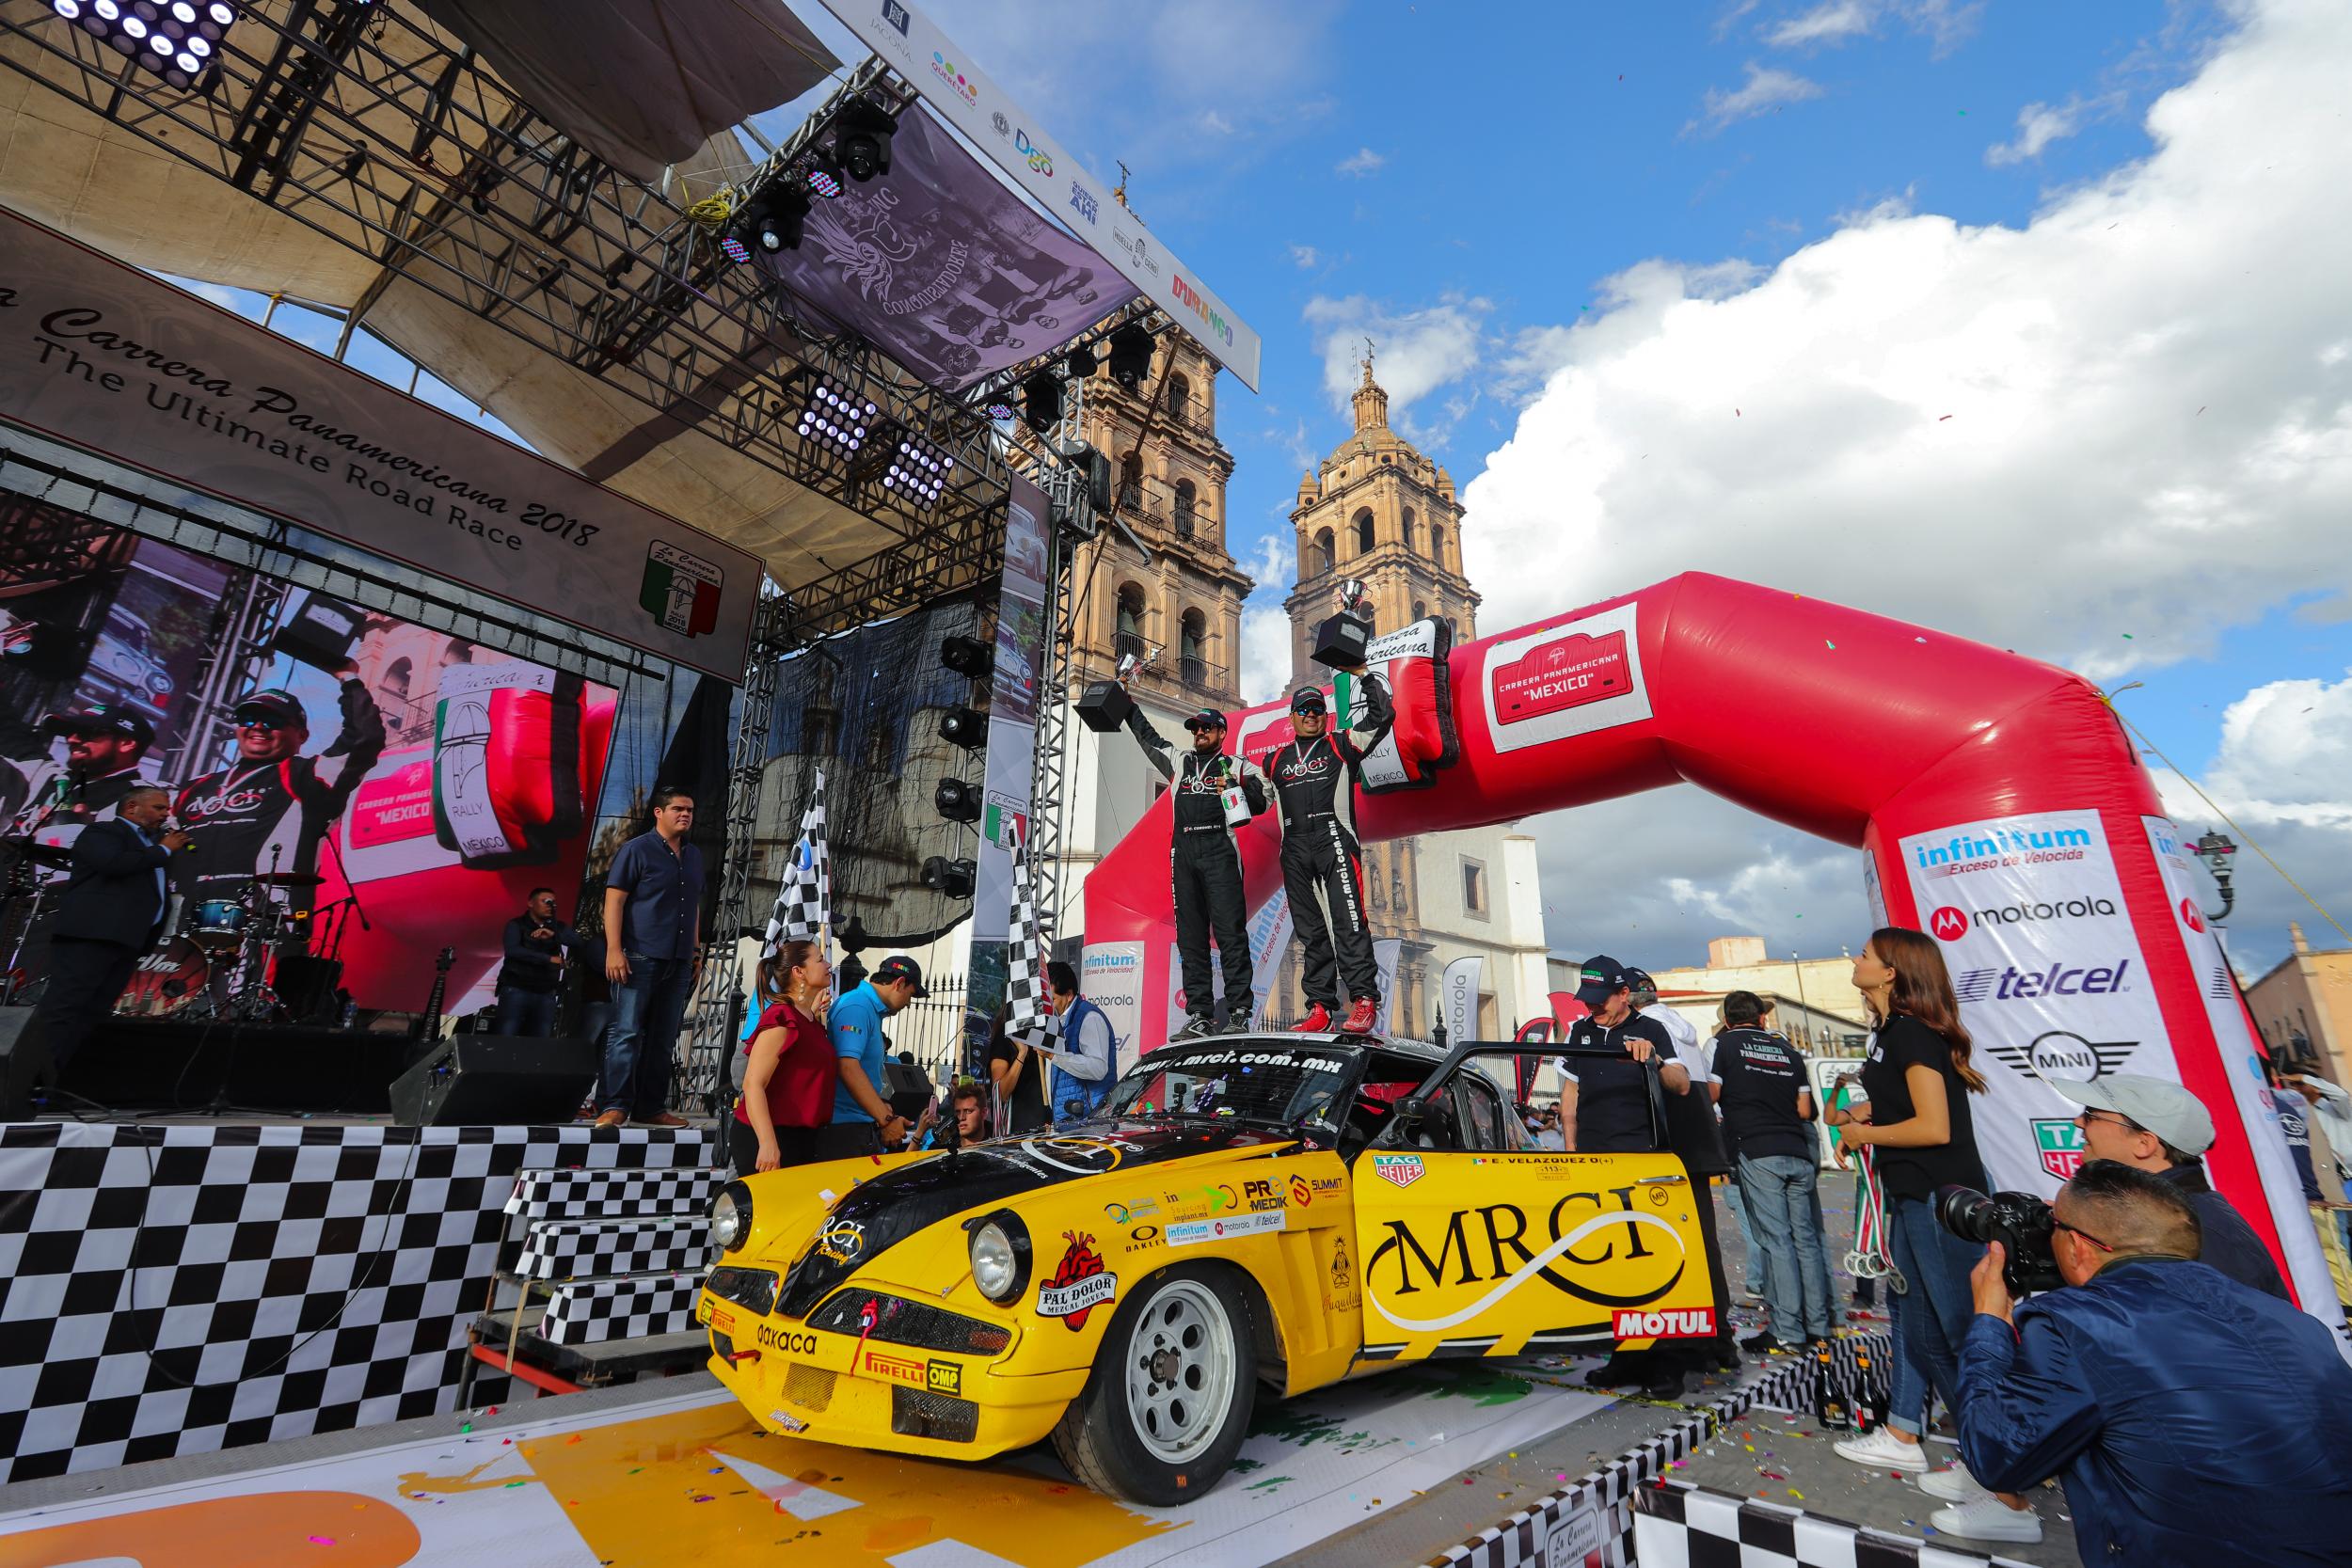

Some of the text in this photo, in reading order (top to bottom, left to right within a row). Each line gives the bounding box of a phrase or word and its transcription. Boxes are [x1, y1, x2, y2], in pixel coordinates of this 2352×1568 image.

[1071, 187, 1098, 214] ESTAR
[1072, 180, 1098, 207] QUIERO
[1172, 274, 1232, 348] DURANGO
[40, 308, 233, 397] Carrera
[248, 386, 509, 514] Panamericana
[519, 501, 600, 547] 2018
[33, 335, 522, 551] The Ultimate Road Race
[654, 551, 720, 585] Panamericana
[678, 555, 715, 575] Carrera
[1499, 653, 1619, 693] CARRERA PANAMERICANA
[1523, 673, 1595, 701] "MEXICO"
[453, 802, 484, 818] RALLY
[1916, 826, 2092, 869] infinitum
[1948, 859, 1998, 876] Exceso
[1973, 895, 2117, 927] motorola
[1995, 958, 2130, 1001] telcel
[2038, 1051, 2091, 1070] MINI
[2042, 1125, 2086, 1147] TA
[1311, 1178, 1343, 1190] SUMMIT
[1379, 1165, 1423, 1185] HEUER
[1249, 1196, 1289, 1212] MEDIK
[1167, 1225, 1208, 1237] infinitum
[1125, 1238, 1167, 1253] OAKLEY
[1072, 1277, 1111, 1301] DOLOR
[1046, 1291, 1105, 1314] MEZCAL JOVEN
[1617, 1312, 1713, 1336] MOTUL
[865, 1352, 926, 1383] PIRELLI
[930, 1370, 958, 1386] OMP
